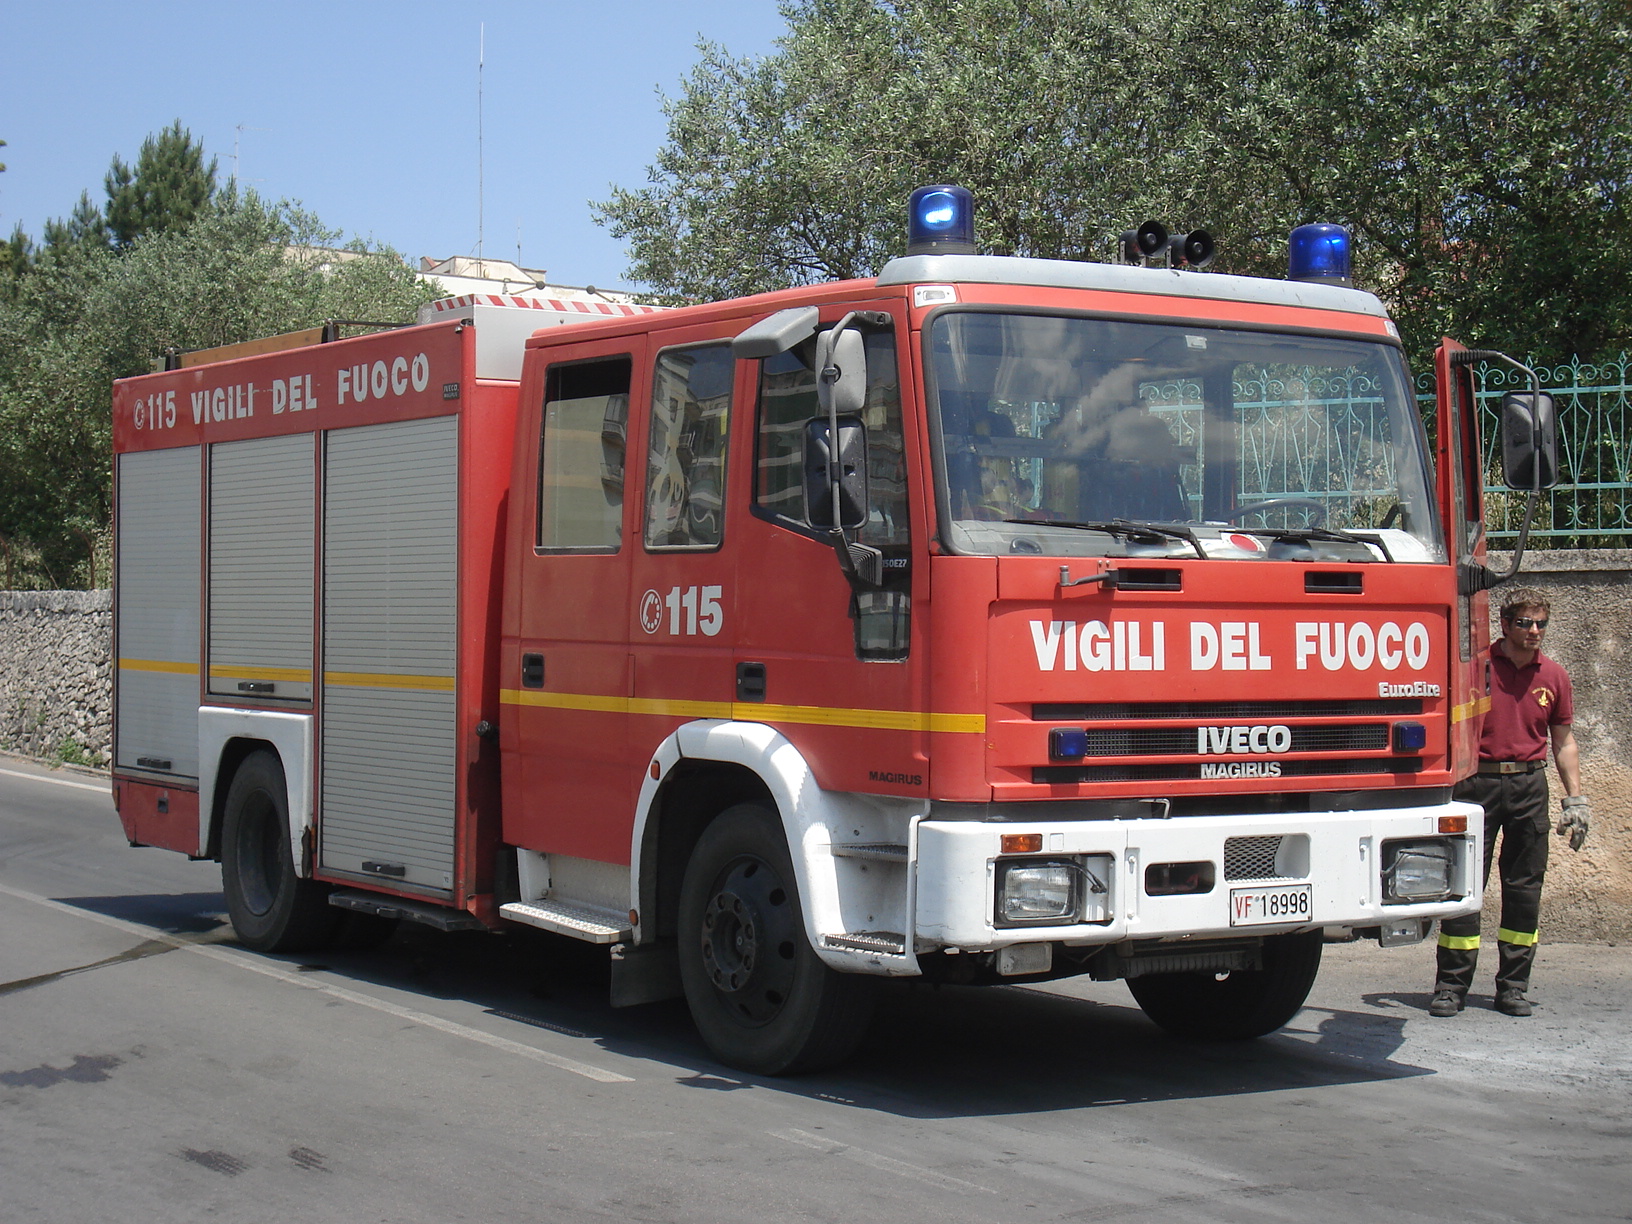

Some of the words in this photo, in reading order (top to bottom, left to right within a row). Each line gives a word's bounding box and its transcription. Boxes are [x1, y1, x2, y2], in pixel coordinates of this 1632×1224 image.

[148, 390, 176, 430] 115
[191, 382, 254, 425] VIGILI
[272, 374, 317, 415] DEL
[338, 352, 429, 405] FUOCO
[665, 585, 723, 637] 115
[1029, 620, 1165, 672] VIGILI
[1190, 621, 1272, 671] DEL
[1295, 621, 1430, 671] FUOCO
[1197, 725, 1292, 754] IVECO
[868, 771, 923, 786] MAGIRUS
[1200, 761, 1282, 780] MAGIRUS
[1234, 895, 1253, 919] VF
[1261, 891, 1308, 917] 18998
